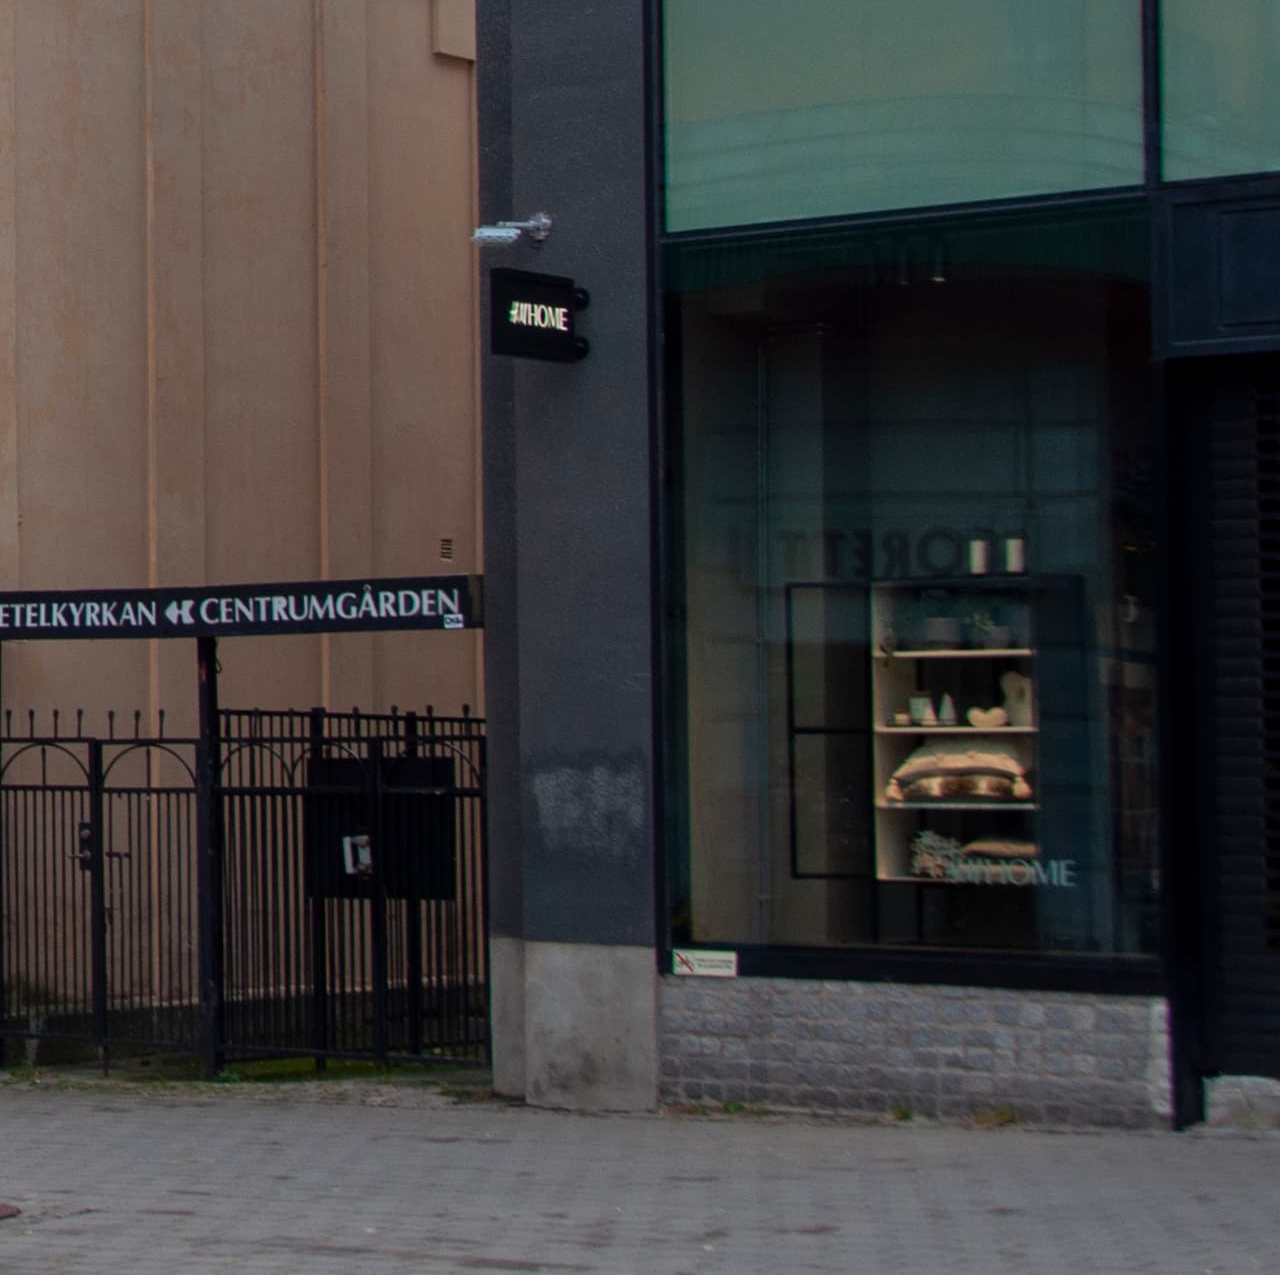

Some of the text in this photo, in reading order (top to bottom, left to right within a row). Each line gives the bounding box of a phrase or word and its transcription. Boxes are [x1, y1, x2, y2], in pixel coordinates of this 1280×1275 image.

[527, 303, 569, 331] HOME
[199, 584, 459, 624] CENTRUMGÅRDEN
[982, 857, 1078, 887] HOME
